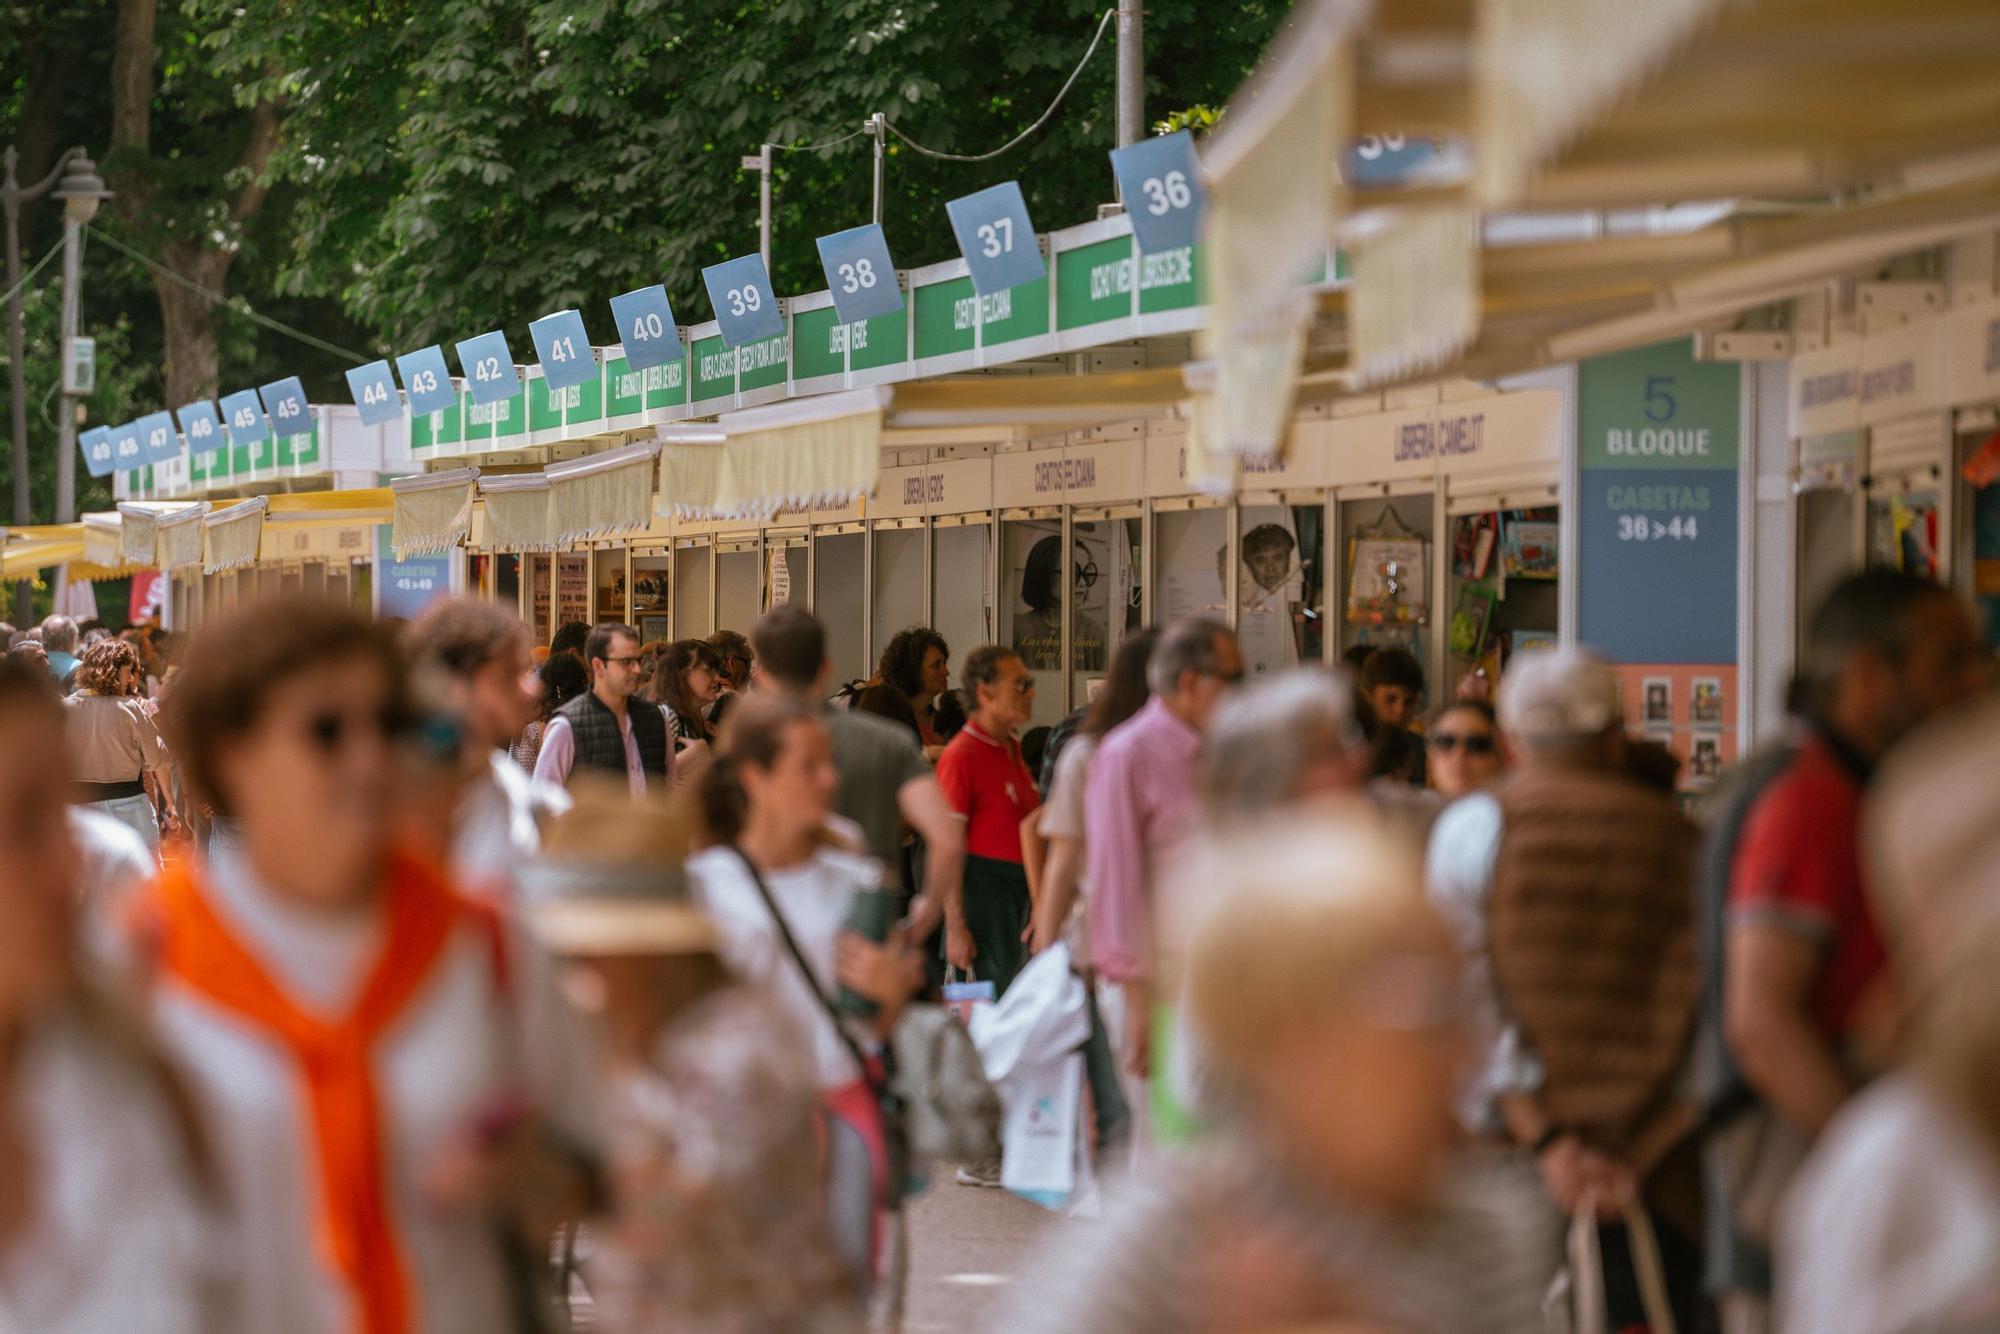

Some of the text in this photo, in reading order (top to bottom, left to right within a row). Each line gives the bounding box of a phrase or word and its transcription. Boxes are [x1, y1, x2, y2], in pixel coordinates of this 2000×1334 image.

[1142, 170, 1192, 216] 36
[977, 216, 1013, 258] 37
[838, 258, 877, 294] 38
[727, 284, 761, 316] 39
[633, 313, 663, 342] 40
[552, 336, 577, 362] 41
[412, 370, 438, 394] 43
[475, 358, 503, 382] 42
[364, 382, 388, 405] 44
[1643, 375, 1678, 424] 5
[234, 407, 256, 429] 45
[278, 398, 300, 419] 45
[150, 428, 167, 448] 47
[191, 417, 213, 438] 46
[1606, 427, 1711, 458] BLOQUE
[928, 473, 945, 502] VERDE
[1606, 485, 1711, 512] CASETAS
[1617, 514, 1699, 542] 36>44
[391, 566, 438, 577] CASETAS
